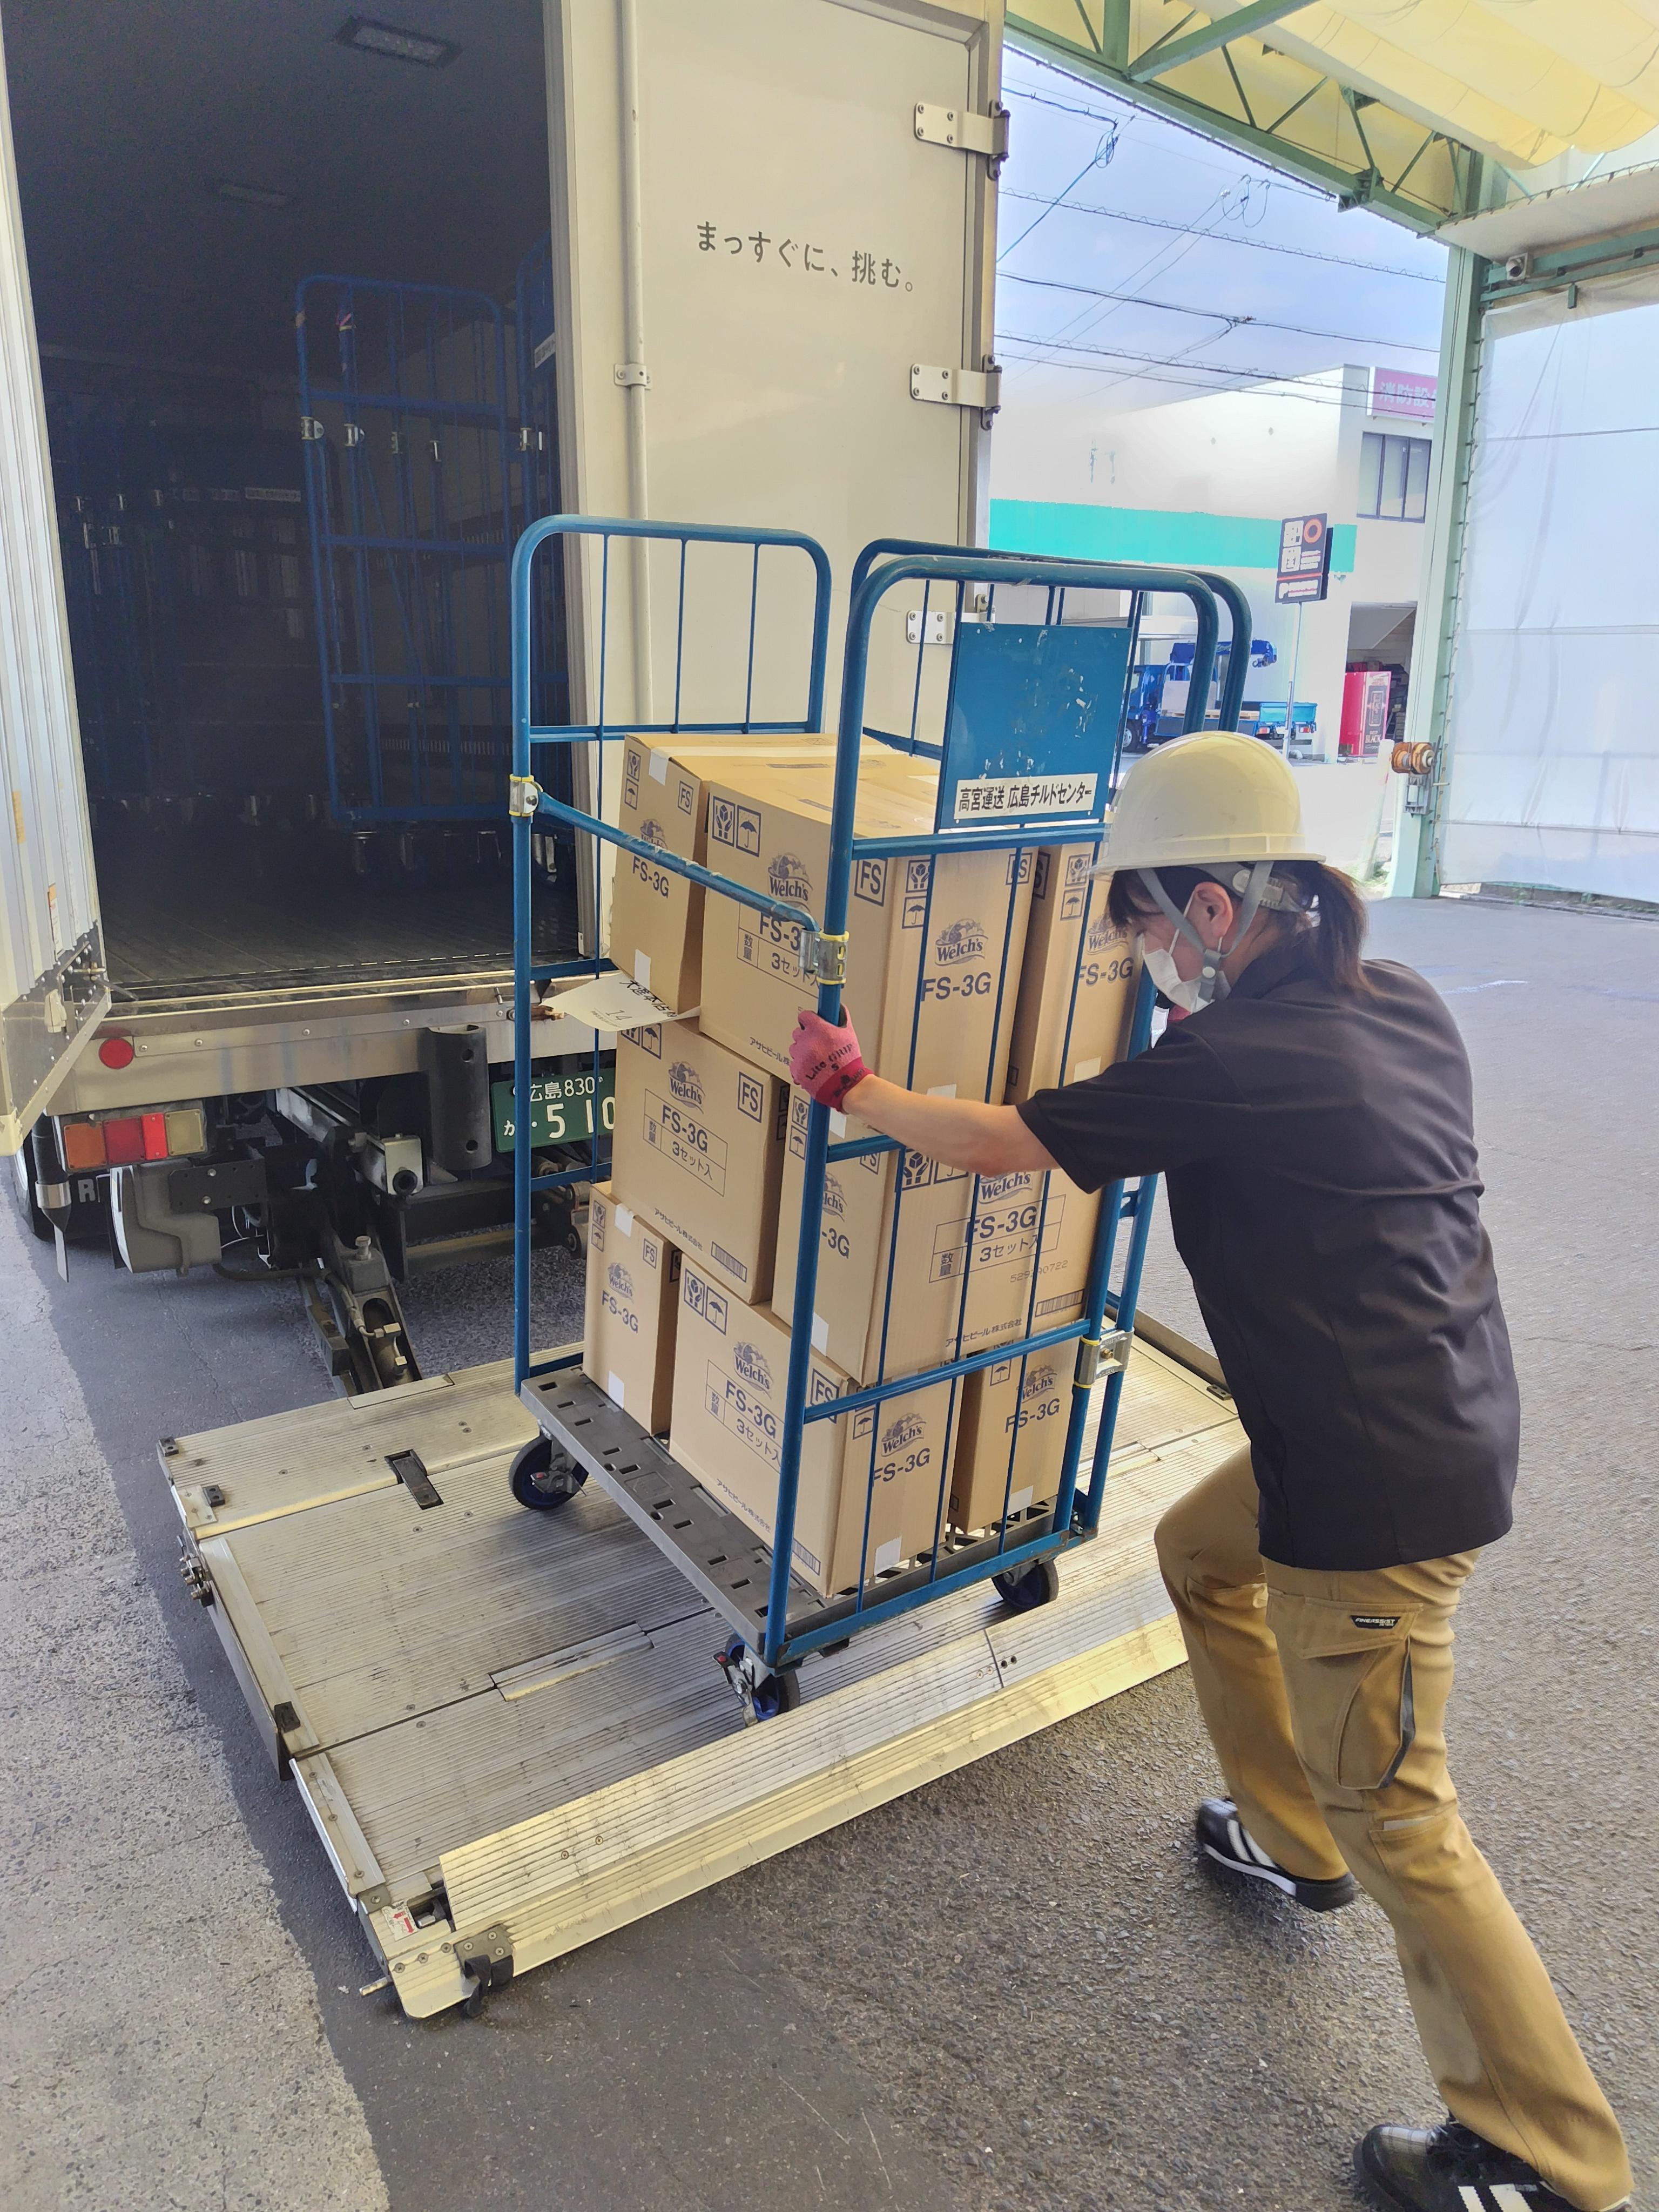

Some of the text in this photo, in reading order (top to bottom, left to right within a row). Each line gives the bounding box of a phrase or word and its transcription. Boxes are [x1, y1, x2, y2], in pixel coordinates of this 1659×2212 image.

[697, 220, 913, 292] まっすぐに、挑む。
[680, 788, 691, 809] FS
[959, 781, 1092, 812] 高宮運送 広島チルドセンター
[632, 855, 670, 899] FS-3G
[769, 875, 809, 902] Welch's
[860, 860, 881, 895] FS
[759, 912, 800, 951] FS-3
[936, 938, 983, 962] Welch's
[920, 972, 992, 1002] FS-3G
[828, 1043, 852, 1062] GRIP
[530, 1076, 595, 1102] 広島 830
[670, 1078, 702, 1105] Welch's
[742, 1082, 759, 1112] FS
[662, 1104, 708, 1154] FS-3G
[672, 1141, 712, 1181] 3セット入
[981, 1172, 1031, 1199] Welch's
[824, 1192, 844, 1213] lch's
[965, 1205, 1037, 1243] FS-3G
[645, 1244, 655, 1263] FS
[609, 1273, 633, 1297] Welch's
[1010, 1259, 1068, 1283] 529A0722
[602, 1290, 638, 1334] FS-3G
[945, 1318, 1022, 1348] アヒビール株式会社
[734, 1354, 770, 1390] Welch's
[725, 1379, 776, 1439] FS-3G
[1005, 1398, 1060, 1434] FS-3G
[736, 1418, 781, 1467] 3セット入
[883, 1425, 922, 1454] Welch's
